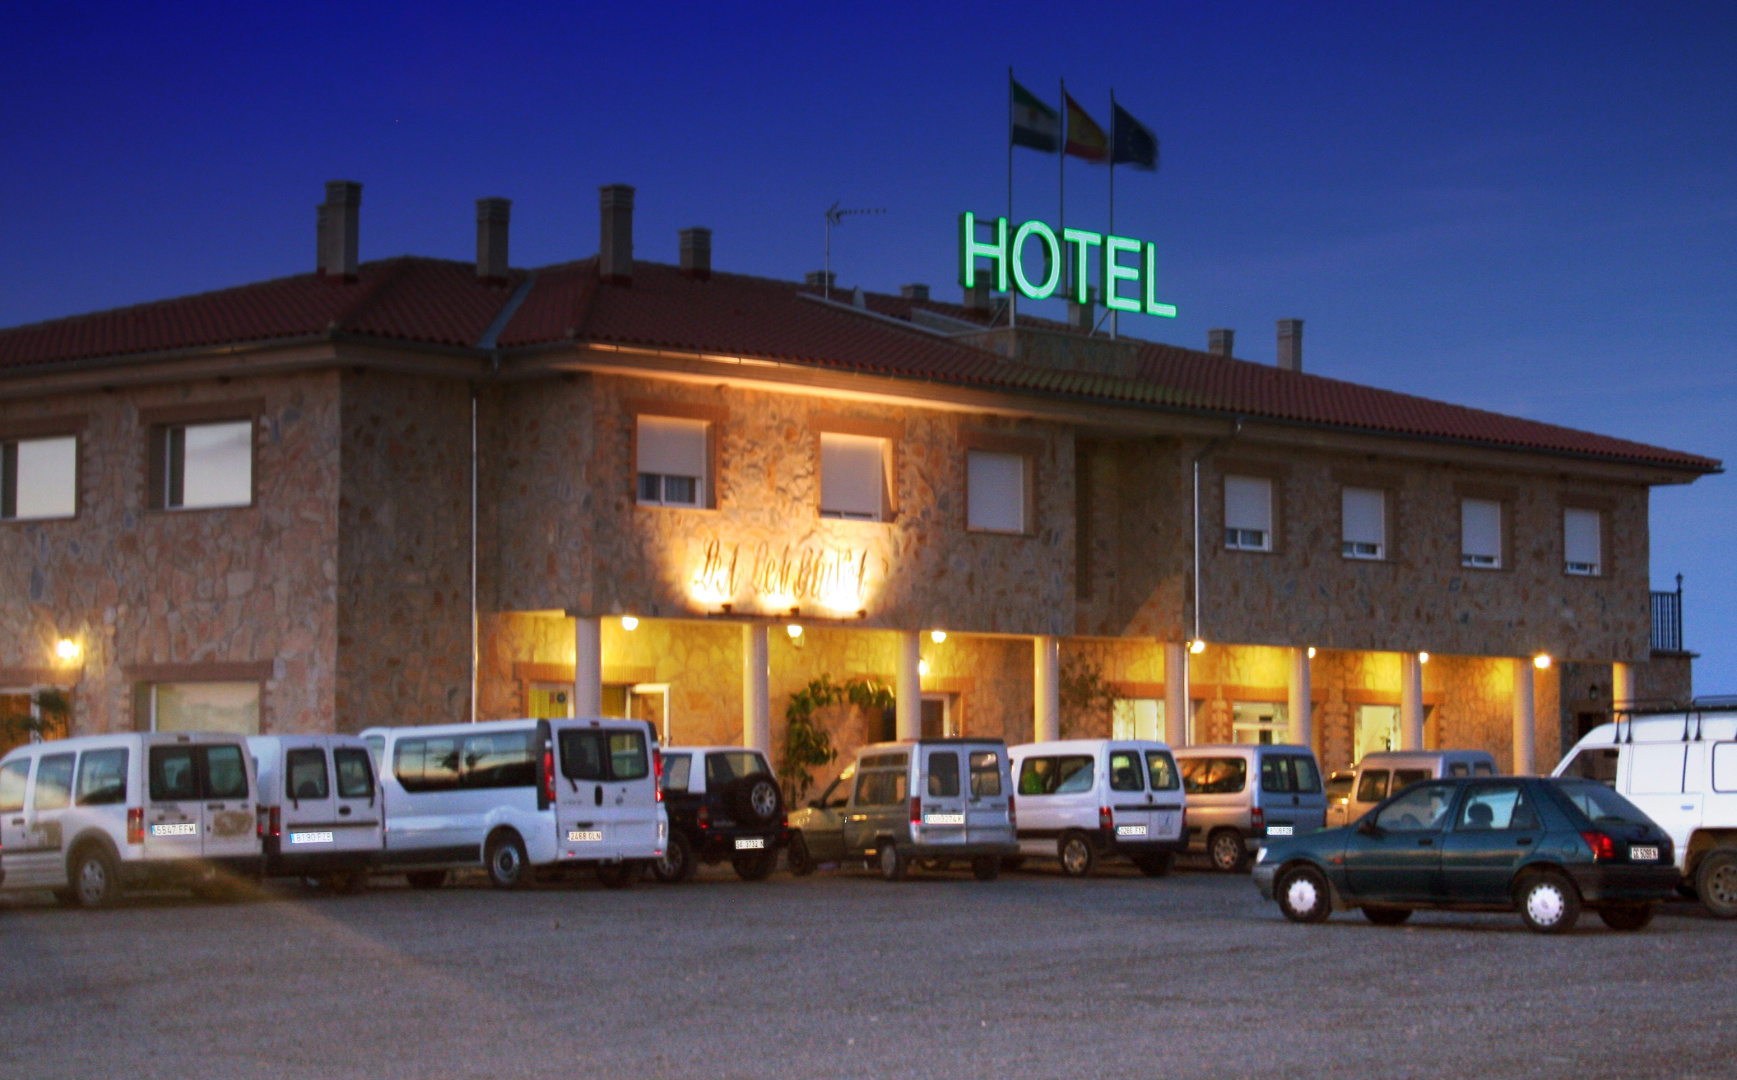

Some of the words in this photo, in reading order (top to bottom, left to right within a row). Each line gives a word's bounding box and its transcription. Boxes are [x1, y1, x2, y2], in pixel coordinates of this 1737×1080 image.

[965, 211, 1177, 318] HOTEL
[156, 825, 176, 835] 5547
[570, 833, 586, 841] 2468
[588, 832, 601, 841] GLN
